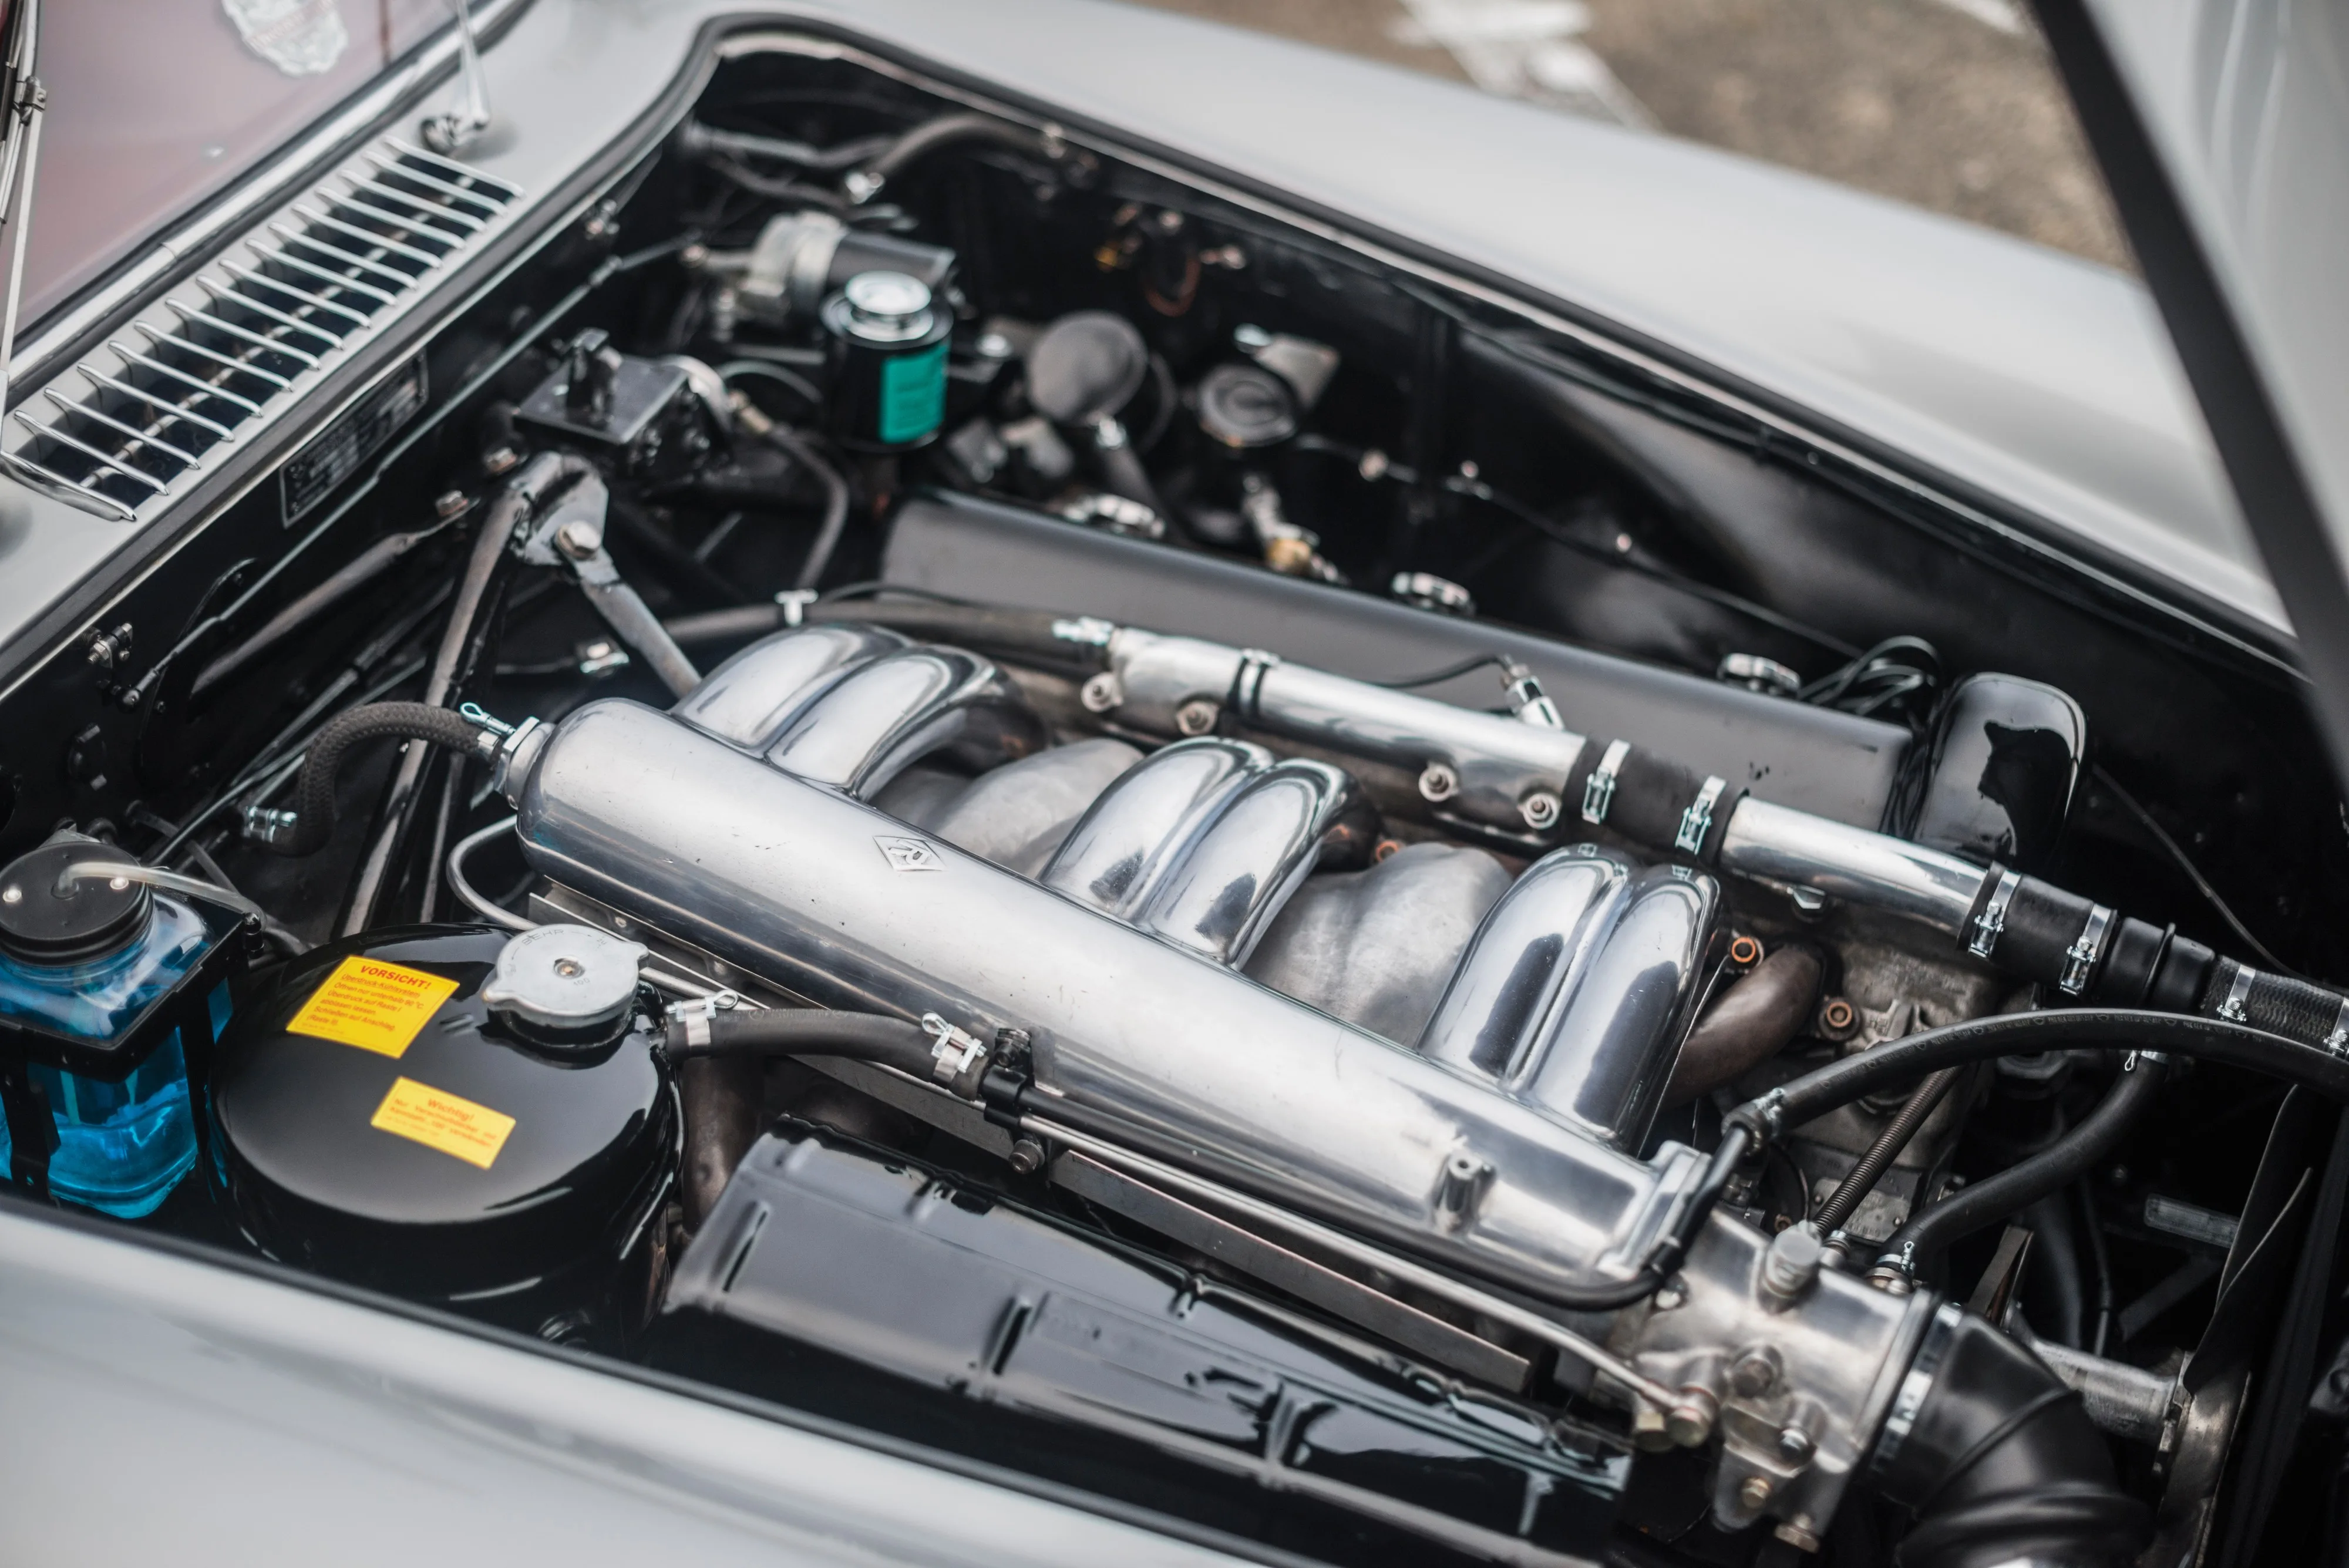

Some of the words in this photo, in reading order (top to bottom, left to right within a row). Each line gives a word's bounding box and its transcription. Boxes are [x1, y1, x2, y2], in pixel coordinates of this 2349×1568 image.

[521, 929, 564, 945] BEHR
[360, 965, 431, 990] VORSICHT!
[364, 997, 376, 1005] auf
[377, 1001, 396, 1011] Raste
